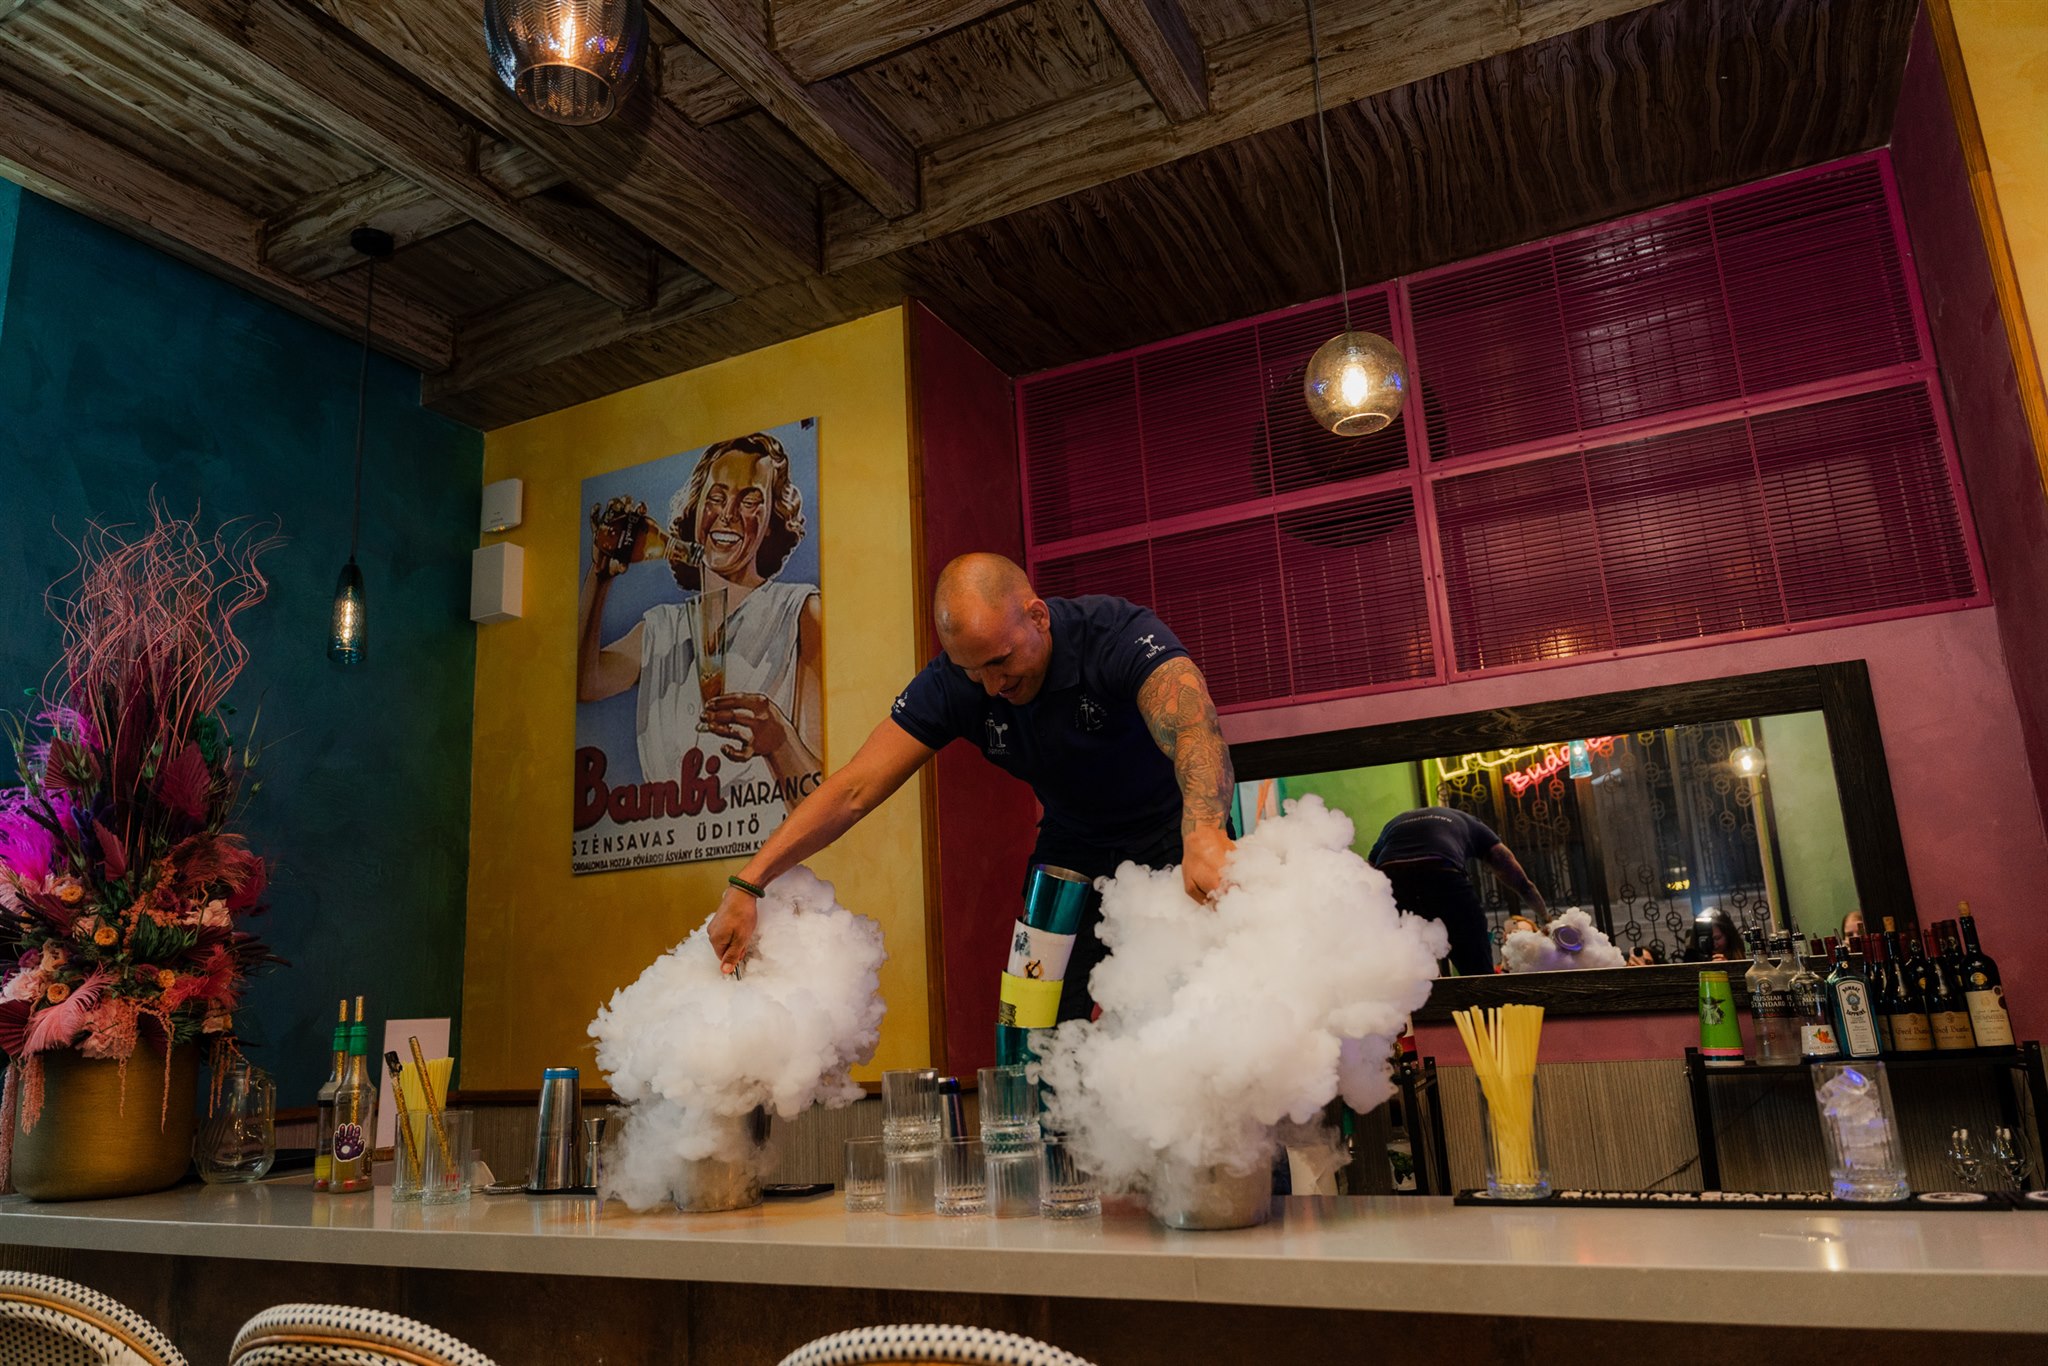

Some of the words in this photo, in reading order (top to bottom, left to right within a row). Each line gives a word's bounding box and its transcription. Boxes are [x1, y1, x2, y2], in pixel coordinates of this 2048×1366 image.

[573, 746, 727, 832] Bambi
[730, 771, 822, 809] NARANCS
[1751, 1000, 1786, 1008] STANDARD
